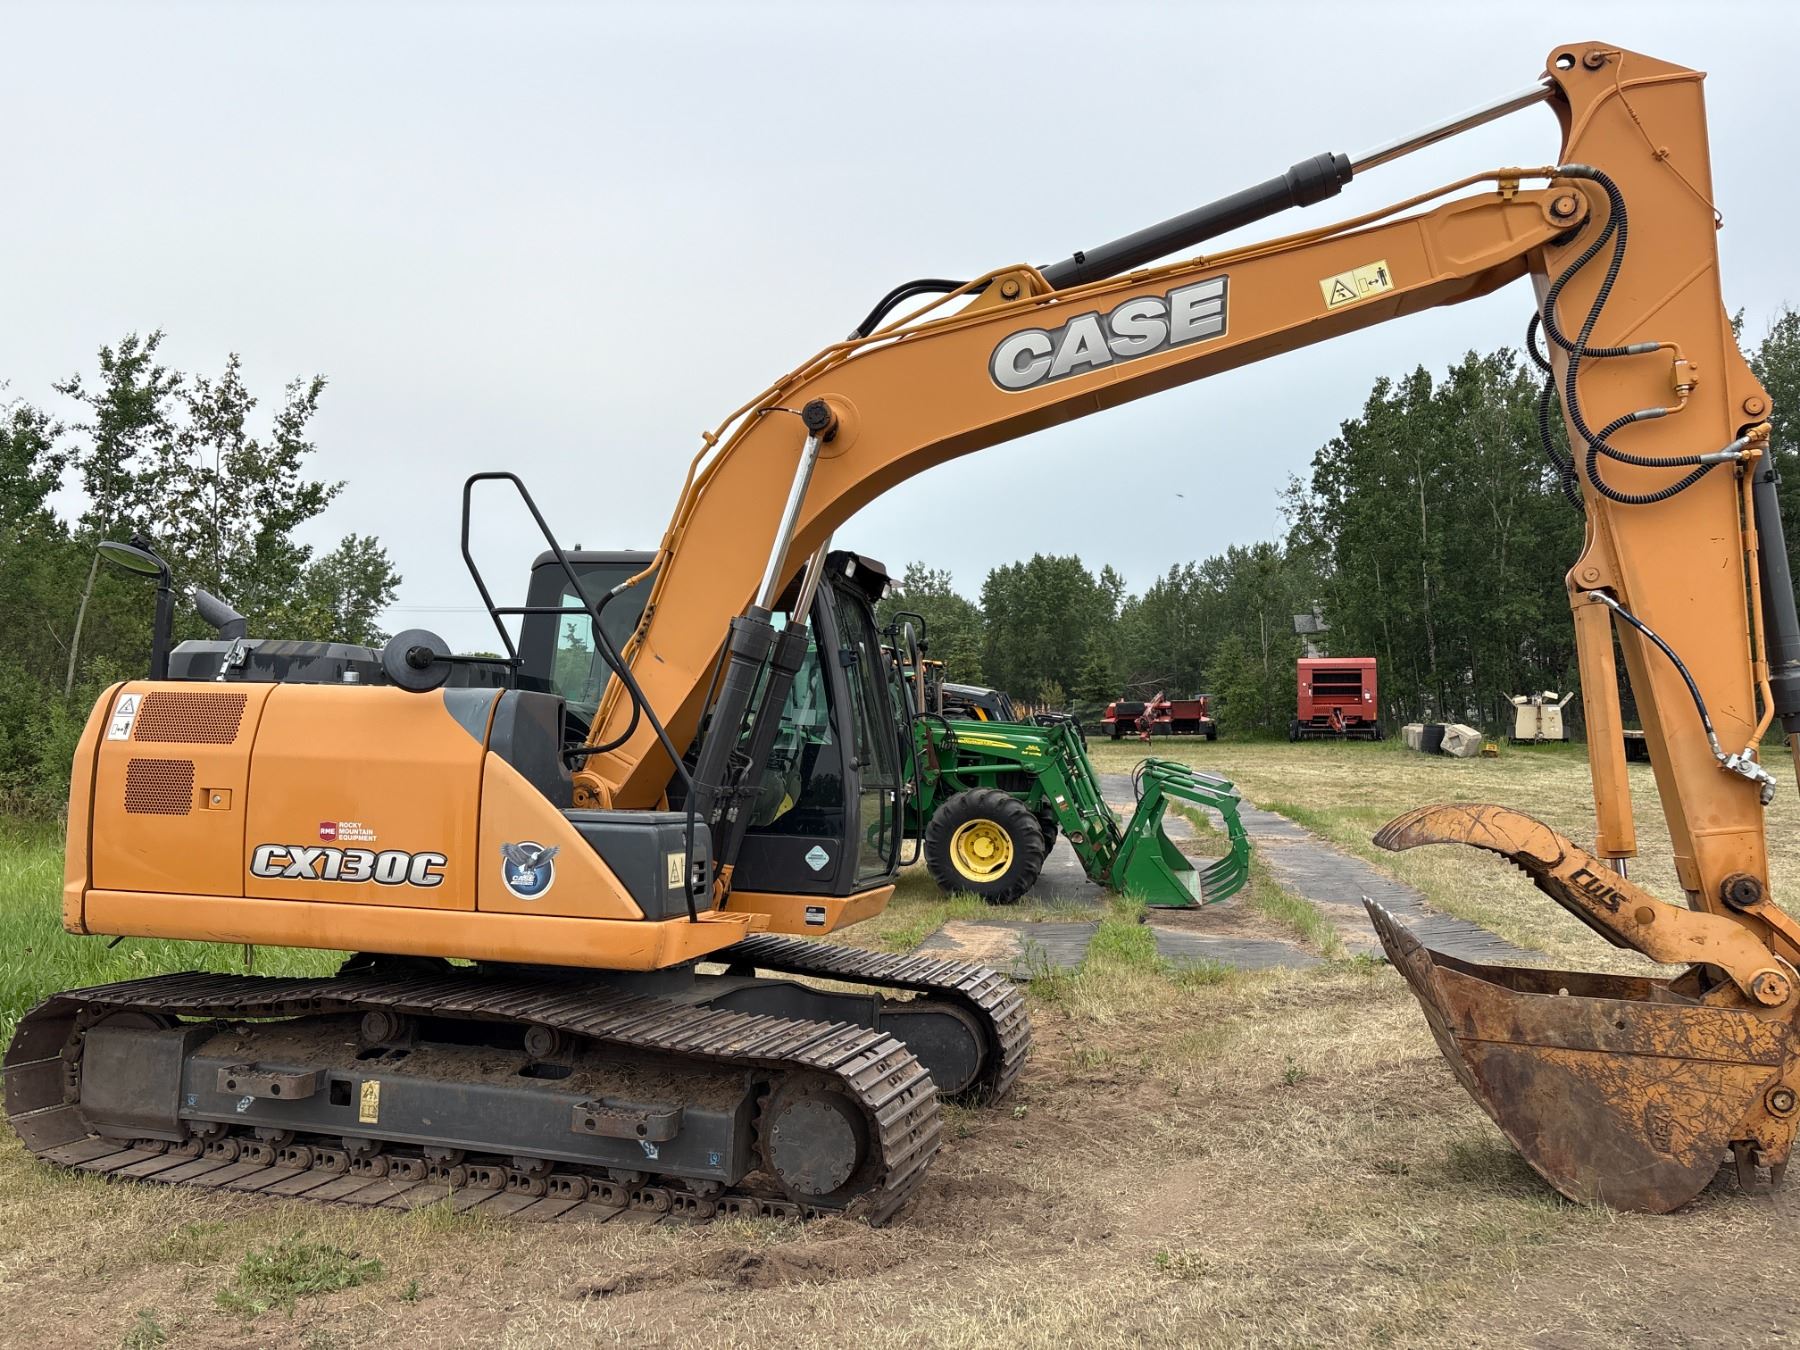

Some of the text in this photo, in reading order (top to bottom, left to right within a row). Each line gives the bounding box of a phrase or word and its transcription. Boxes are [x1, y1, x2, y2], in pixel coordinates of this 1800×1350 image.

[992, 276, 1226, 390] CASE
[338, 834, 377, 842] EQUIPMENT
[250, 844, 449, 888] CX130C
